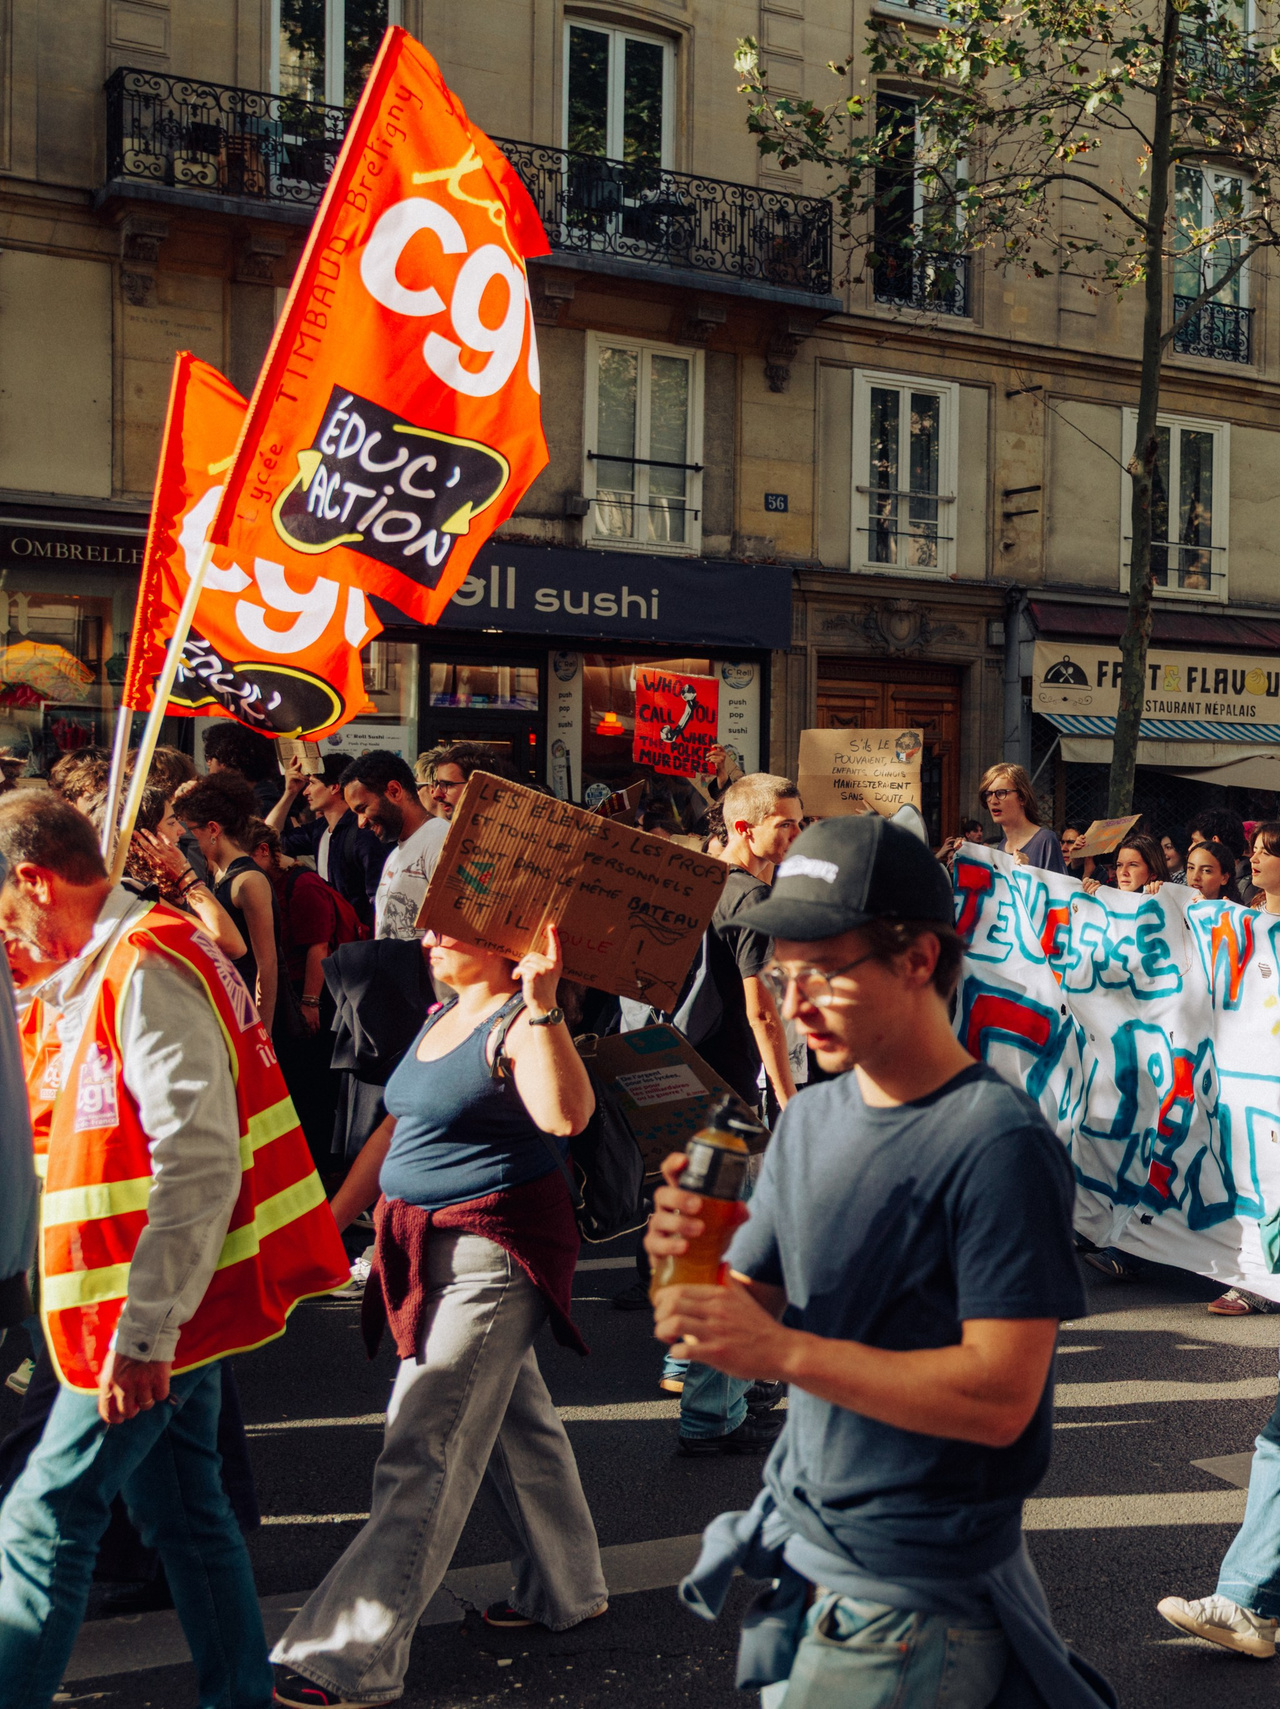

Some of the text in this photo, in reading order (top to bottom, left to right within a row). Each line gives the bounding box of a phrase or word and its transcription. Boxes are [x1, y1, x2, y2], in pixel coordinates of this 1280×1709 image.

[276, 235, 348, 403] TIMBAUD
[344, 83, 423, 215] Brétigny
[360, 197, 542, 398] cg
[768, 496, 785, 511] 56
[534, 586, 660, 620] sushi
[1163, 665, 1182, 692] &
[639, 704, 676, 724] CALL
[729, 712, 744, 720] pop
[1143, 699, 1256, 717] STAURANT NÉPALAIS
[639, 749, 710, 774] MURDERS
[840, 792, 864, 801] SANS
[874, 793, 904, 804] DOUTE
[479, 783, 519, 810] LES
[630, 837, 663, 857] LES
[667, 853, 727, 885] PROFS
[471, 813, 494, 828] ET
[583, 850, 694, 897] PERSONNELS
[460, 838, 508, 860] SONT
[514, 857, 553, 879] DANS
[557, 874, 574, 887] LE
[627, 896, 699, 928] BATEAU
